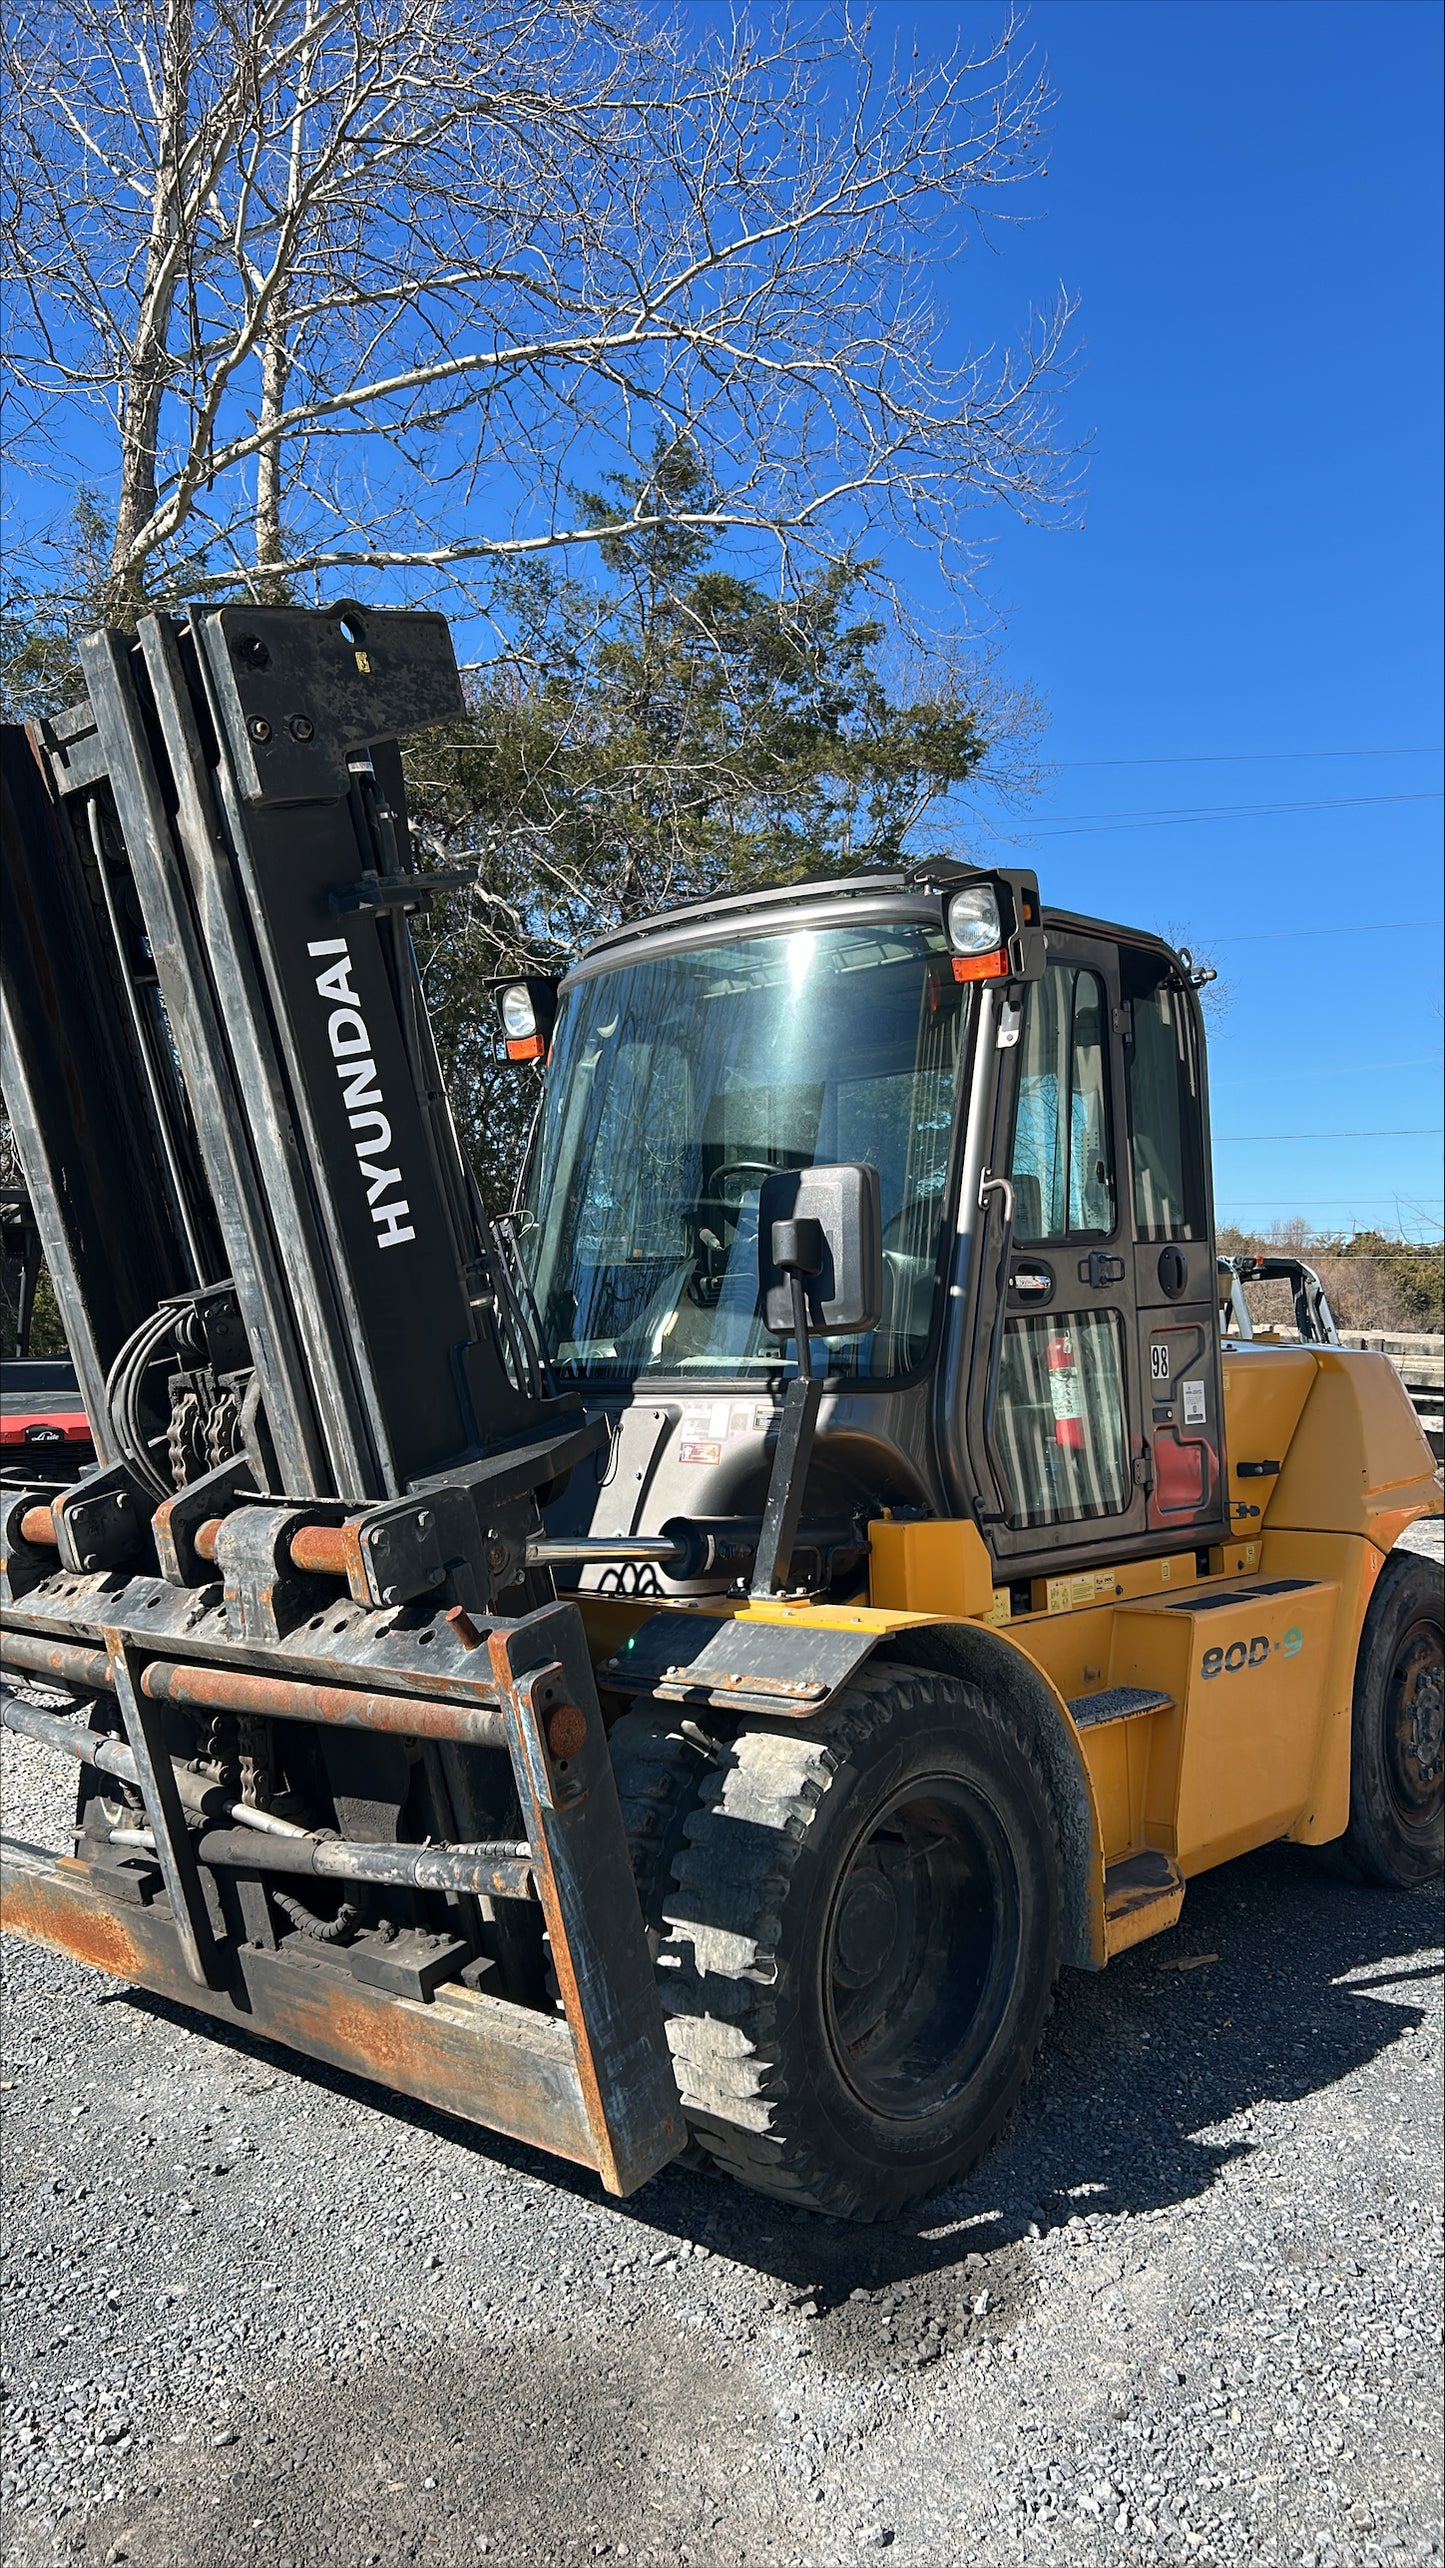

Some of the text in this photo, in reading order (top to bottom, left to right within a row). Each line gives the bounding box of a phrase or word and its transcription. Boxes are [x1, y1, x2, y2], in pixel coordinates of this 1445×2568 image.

[307, 938, 416, 1248] HYUNDAI
[1152, 1346, 1168, 1377] 98
[1201, 1627, 1303, 1680] 80D-9
